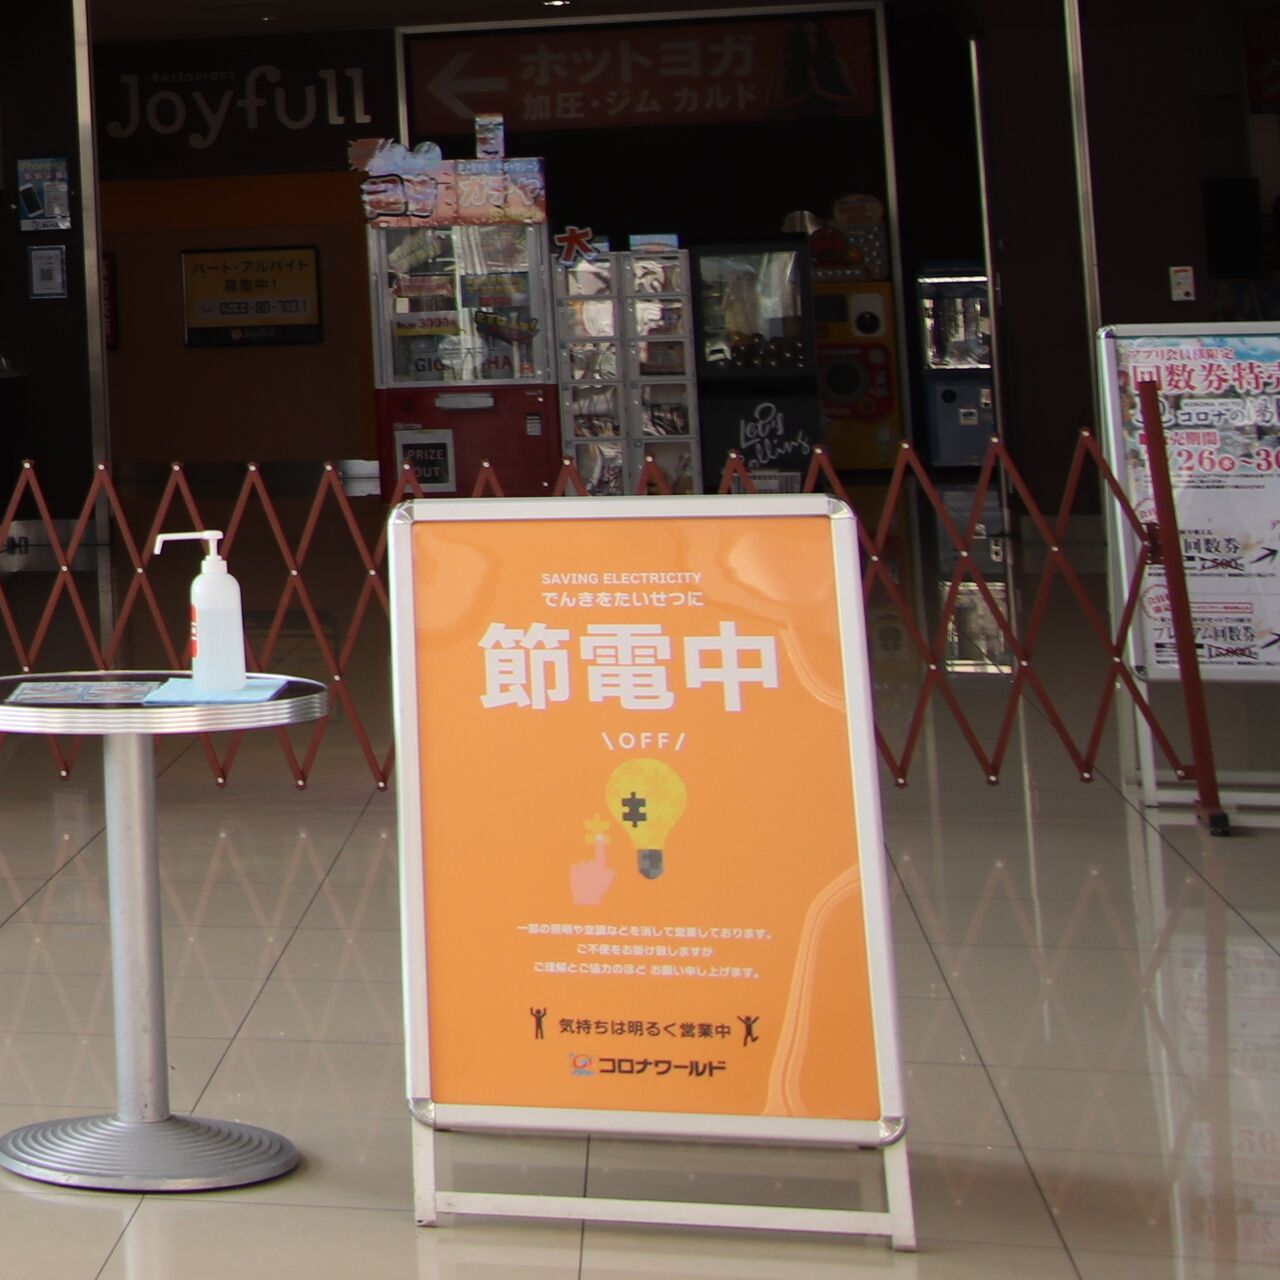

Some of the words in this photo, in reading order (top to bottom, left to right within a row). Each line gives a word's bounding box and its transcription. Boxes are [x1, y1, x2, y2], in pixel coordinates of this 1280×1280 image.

[519, 31, 757, 89] ホットヨガ
[106, 64, 373, 150] Joyfull
[521, 88, 663, 122] 加圧・ジム
[671, 83, 760, 114] カルド
[192, 257, 311, 275] パート・アルバイト
[1176, 398, 1274, 425] コロナの湯
[406, 447, 445, 461] PRIZE
[541, 572, 599, 585] SAVING
[603, 571, 703, 585] ELECTRICITY
[541, 590, 705, 608] でんきをたいせつに
[477, 620, 779, 713] 節電中
[558, 1017, 732, 1040] 気持ちは明るく営業中
[598, 1056, 728, 1078] コロナワールド
